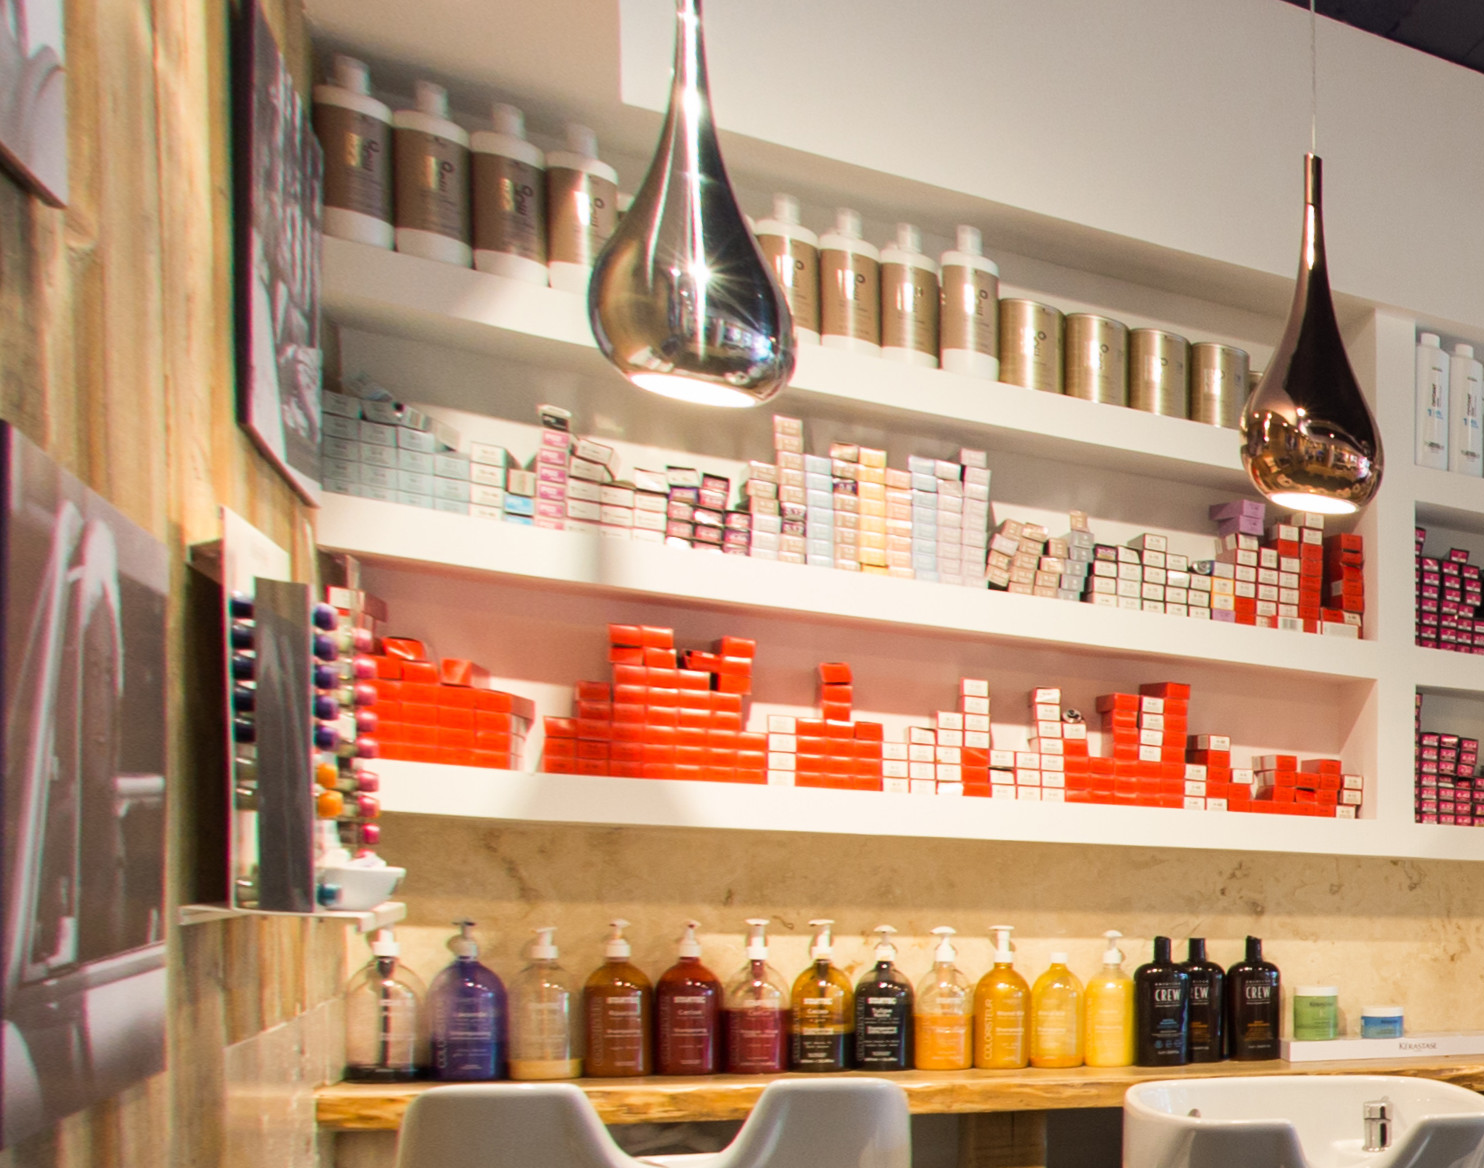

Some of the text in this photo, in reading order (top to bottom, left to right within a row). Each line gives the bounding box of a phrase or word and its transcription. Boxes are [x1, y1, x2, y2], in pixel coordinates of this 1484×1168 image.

[1154, 989, 1181, 1001] CREW
[1191, 987, 1209, 999] EW
[1245, 987, 1271, 999] CREW
[984, 999, 994, 1060] COLORISTEUR
